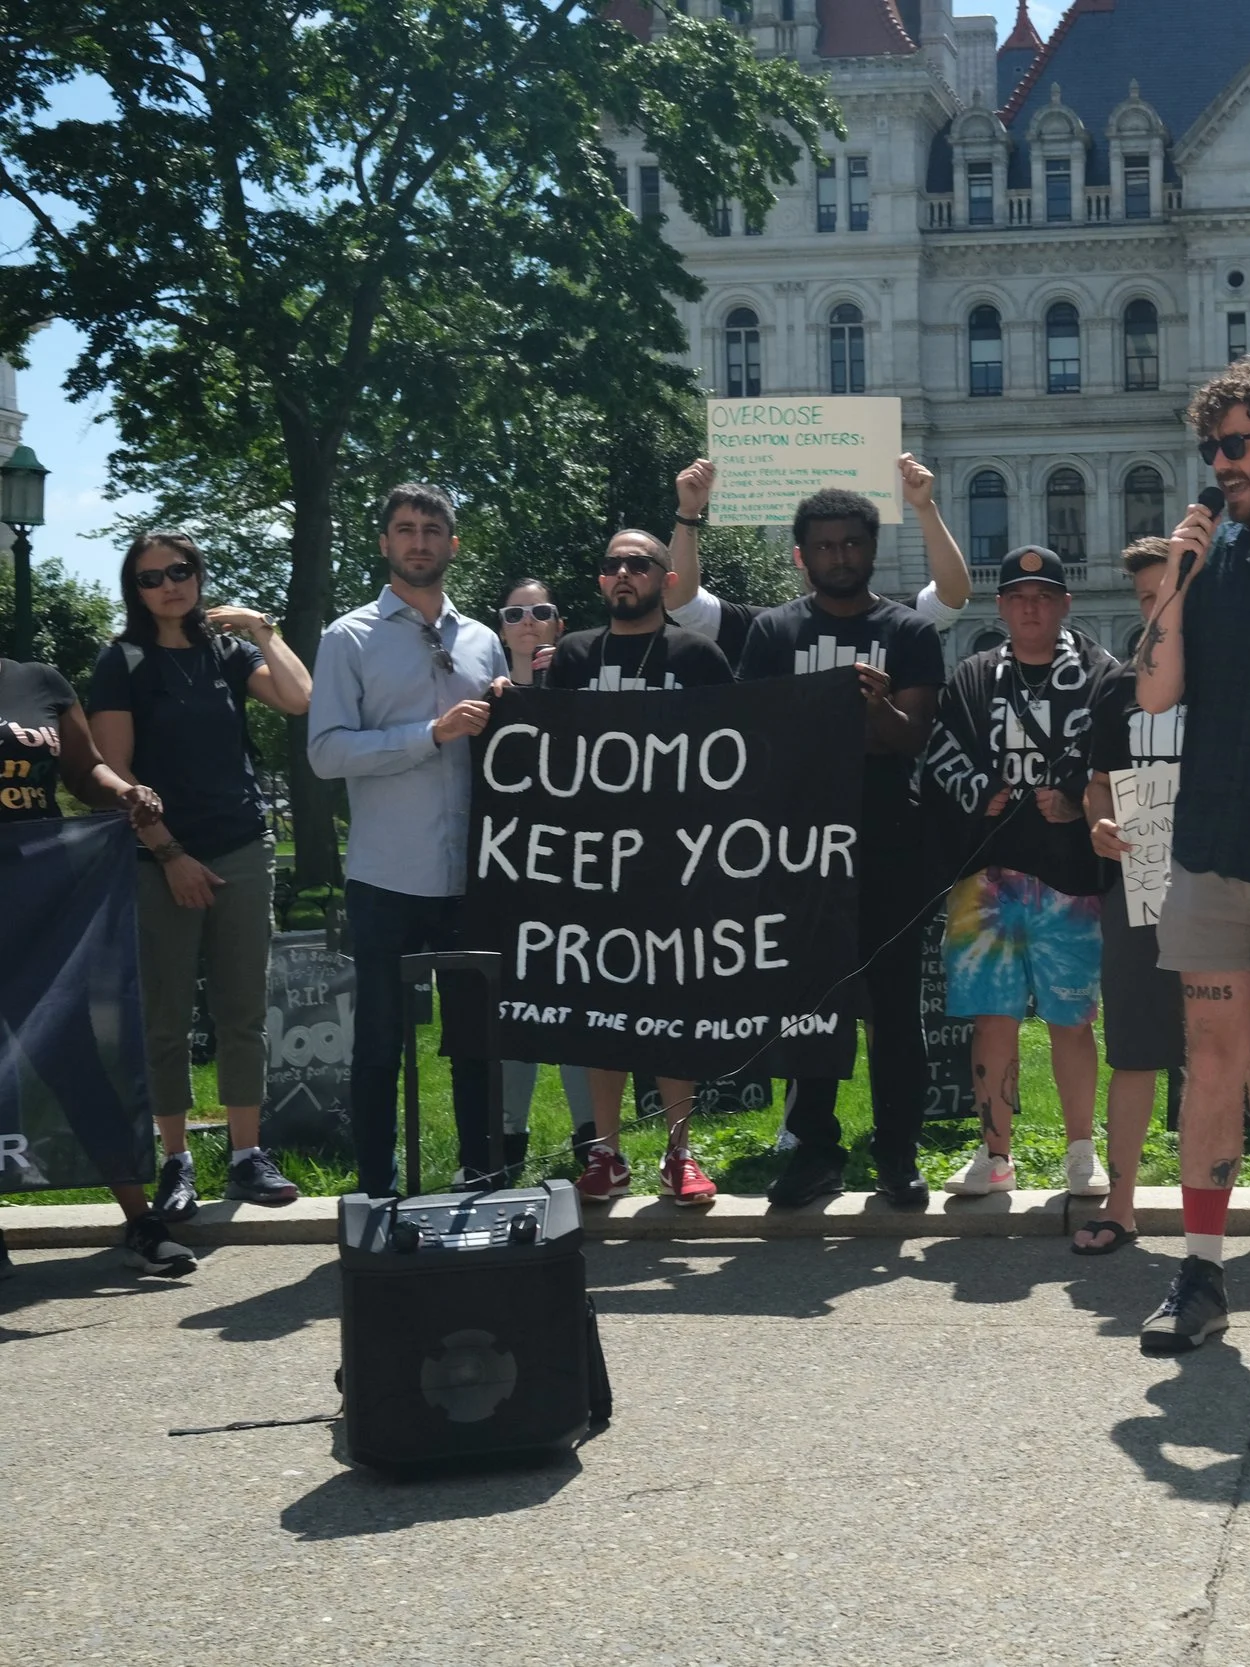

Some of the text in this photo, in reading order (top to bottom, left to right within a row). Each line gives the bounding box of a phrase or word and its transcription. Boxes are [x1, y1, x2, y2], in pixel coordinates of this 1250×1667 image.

[712, 405, 823, 428] OVERDOSE
[712, 433, 865, 447] PREVENTION CENTERS:
[483, 723, 747, 798] CUOMO
[478, 815, 858, 892] KEEP YOUR
[516, 912, 789, 986] PROMISE
[499, 1000, 839, 1041] START THE OPC PILOT NOW
